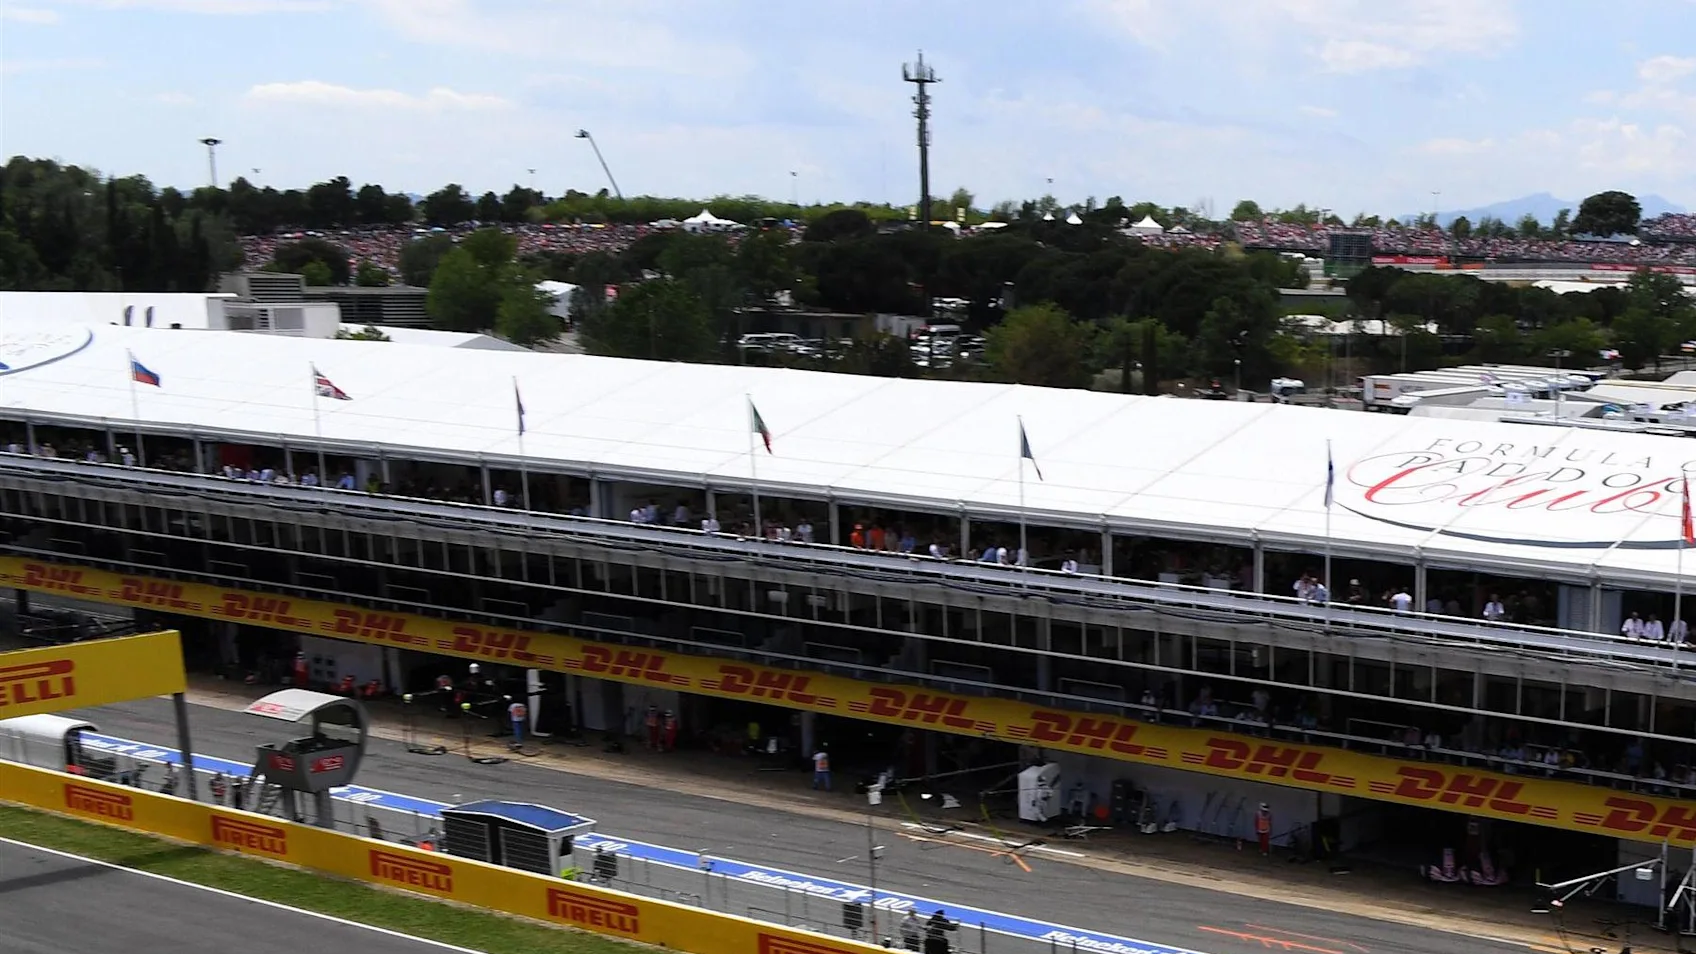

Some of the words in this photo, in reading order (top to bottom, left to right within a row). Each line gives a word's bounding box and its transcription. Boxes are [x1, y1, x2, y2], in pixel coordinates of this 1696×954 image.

[1426, 438, 1652, 468] FORMULA
[1347, 452, 1680, 518] Club
[23, 563, 86, 594] DHL
[120, 578, 188, 609] DHL
[222, 593, 295, 625] DHL
[334, 608, 412, 644] DHL
[452, 626, 538, 662] DHL
[581, 645, 672, 679] DHL
[718, 664, 816, 706] DHL
[869, 686, 976, 728] DHL
[1029, 710, 1145, 756] DHL
[1205, 737, 1331, 784] DHL
[64, 783, 134, 822] PIRELLI
[1396, 766, 1531, 814] DHL
[211, 814, 288, 856] PIRELLI
[369, 849, 453, 894] PIRELLI
[739, 870, 841, 898] Heineken
[547, 887, 640, 934] PIRELLI
